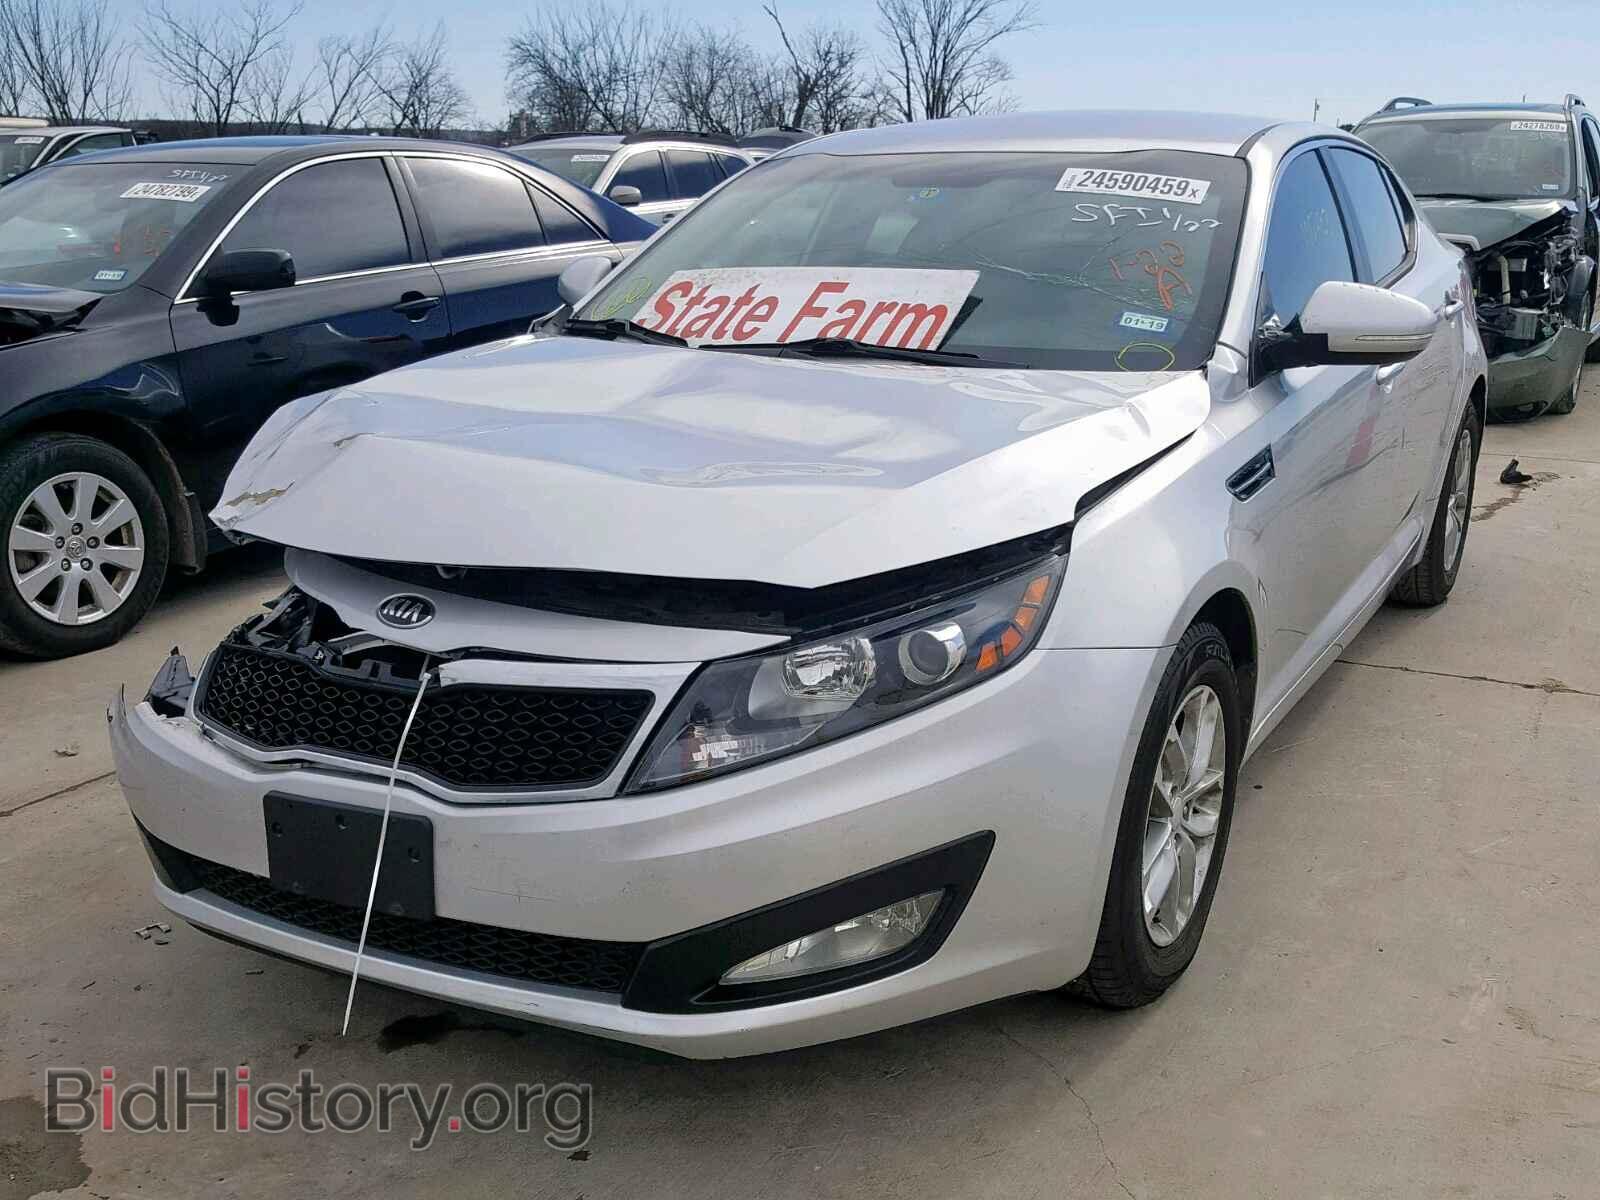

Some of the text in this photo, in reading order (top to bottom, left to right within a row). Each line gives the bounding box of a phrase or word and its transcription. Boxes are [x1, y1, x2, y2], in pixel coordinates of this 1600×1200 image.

[639, 280, 779, 342] State
[777, 281, 949, 351] Farm
[382, 598, 424, 623] KIA
